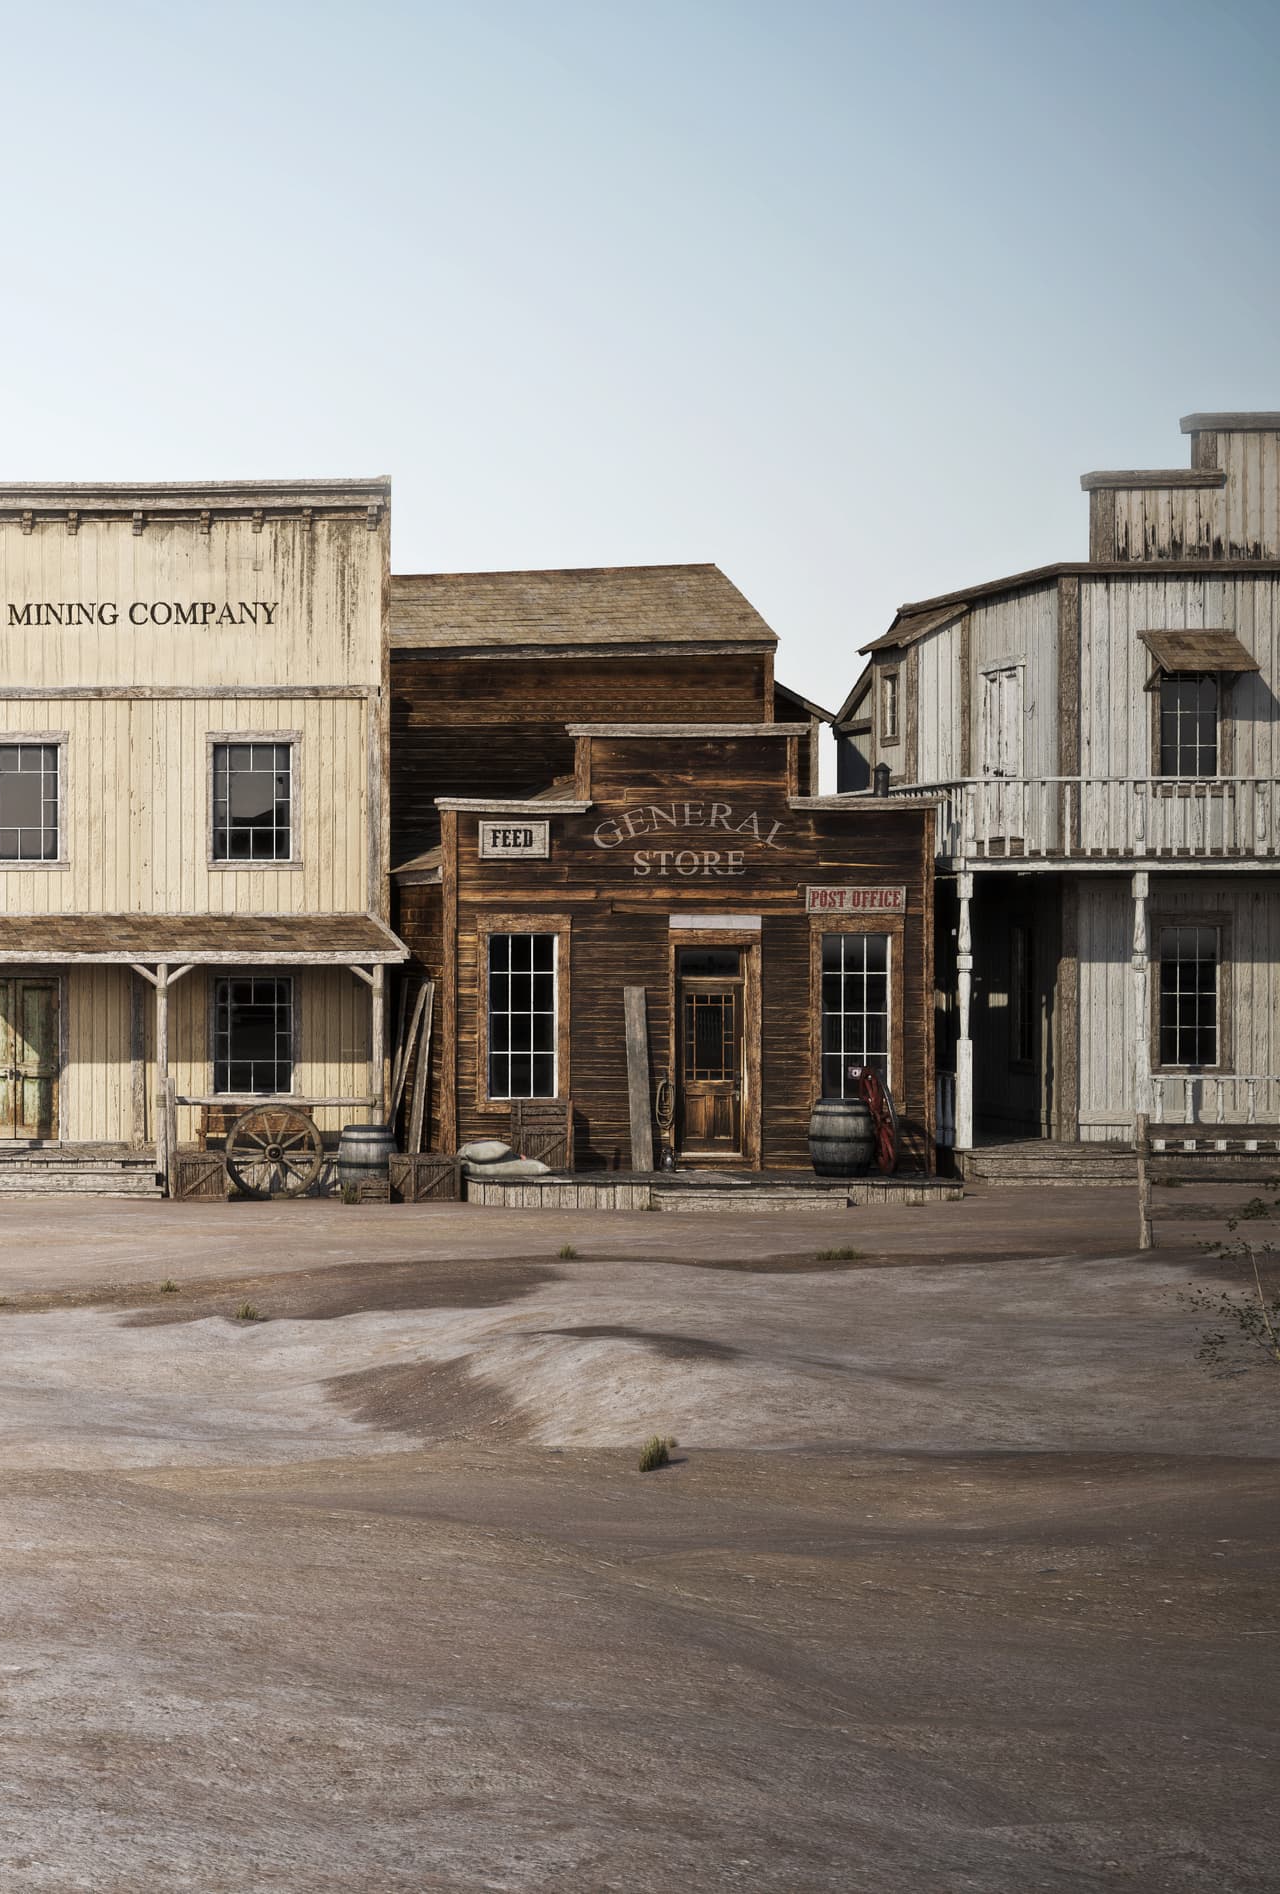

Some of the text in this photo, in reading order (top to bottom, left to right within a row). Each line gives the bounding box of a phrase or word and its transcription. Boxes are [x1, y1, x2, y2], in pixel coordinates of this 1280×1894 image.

[7, 602, 279, 626] MINING COMPANY
[491, 829, 533, 848] FEED
[593, 802, 787, 851] GENERAL
[633, 850, 745, 876] STORE
[810, 890, 901, 908] POST OFFICE
